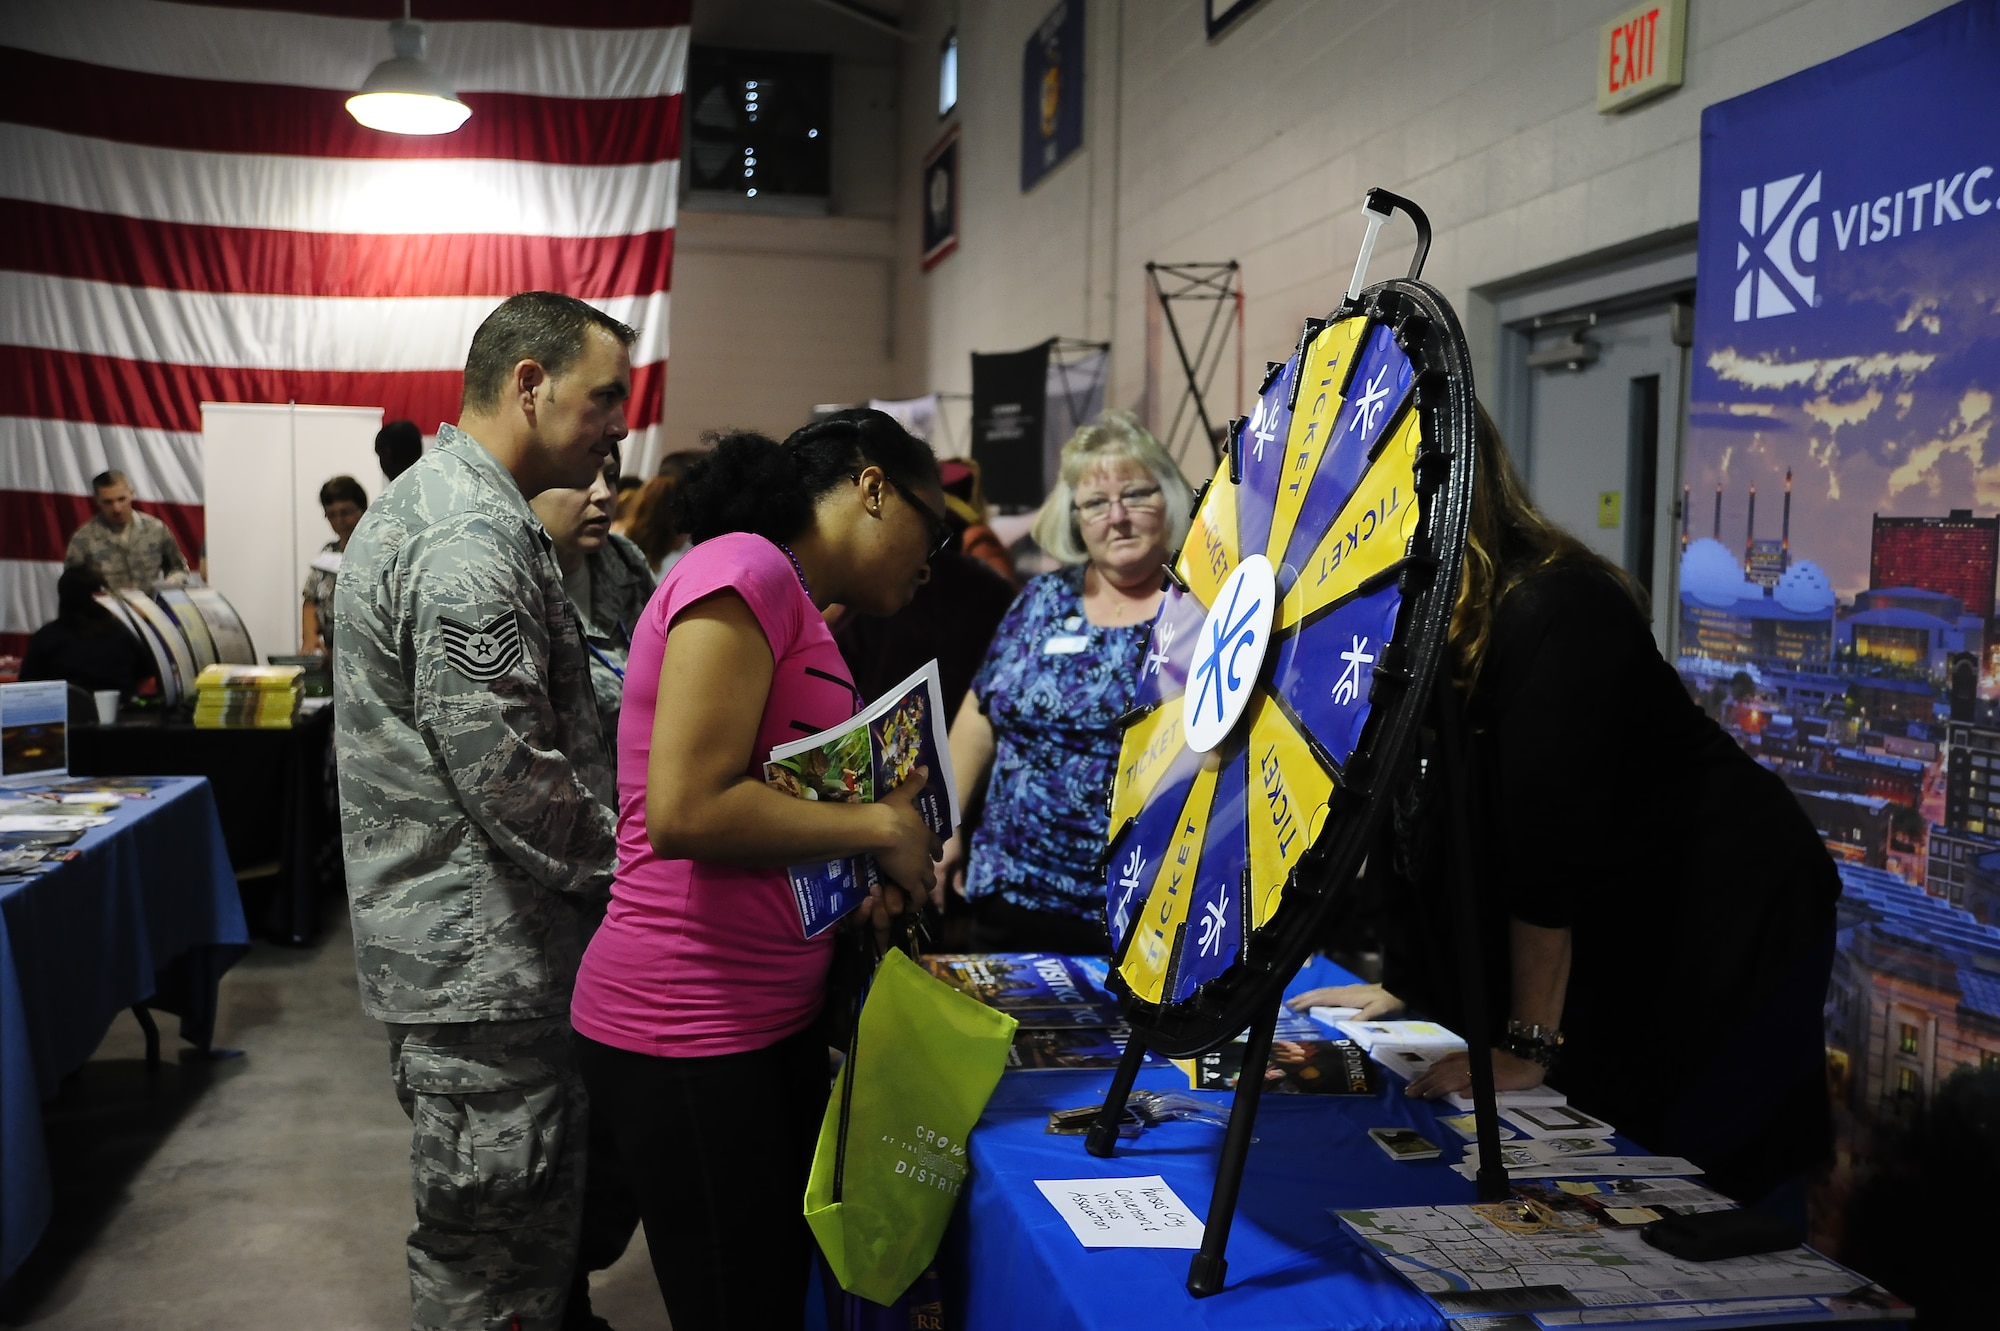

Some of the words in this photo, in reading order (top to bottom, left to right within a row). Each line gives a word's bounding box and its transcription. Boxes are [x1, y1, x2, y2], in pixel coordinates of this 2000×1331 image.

[1609, 8, 1659, 94] EXIT
[1288, 350, 1342, 498] TICKET
[1316, 485, 1400, 588] TICKET
[1126, 717, 1180, 789] TICKET
[1260, 743, 1298, 860] TICKET
[1145, 816, 1197, 964] TICKET
[894, 1160, 961, 1197] DISTRIC
[916, 1125, 966, 1157] CROW
